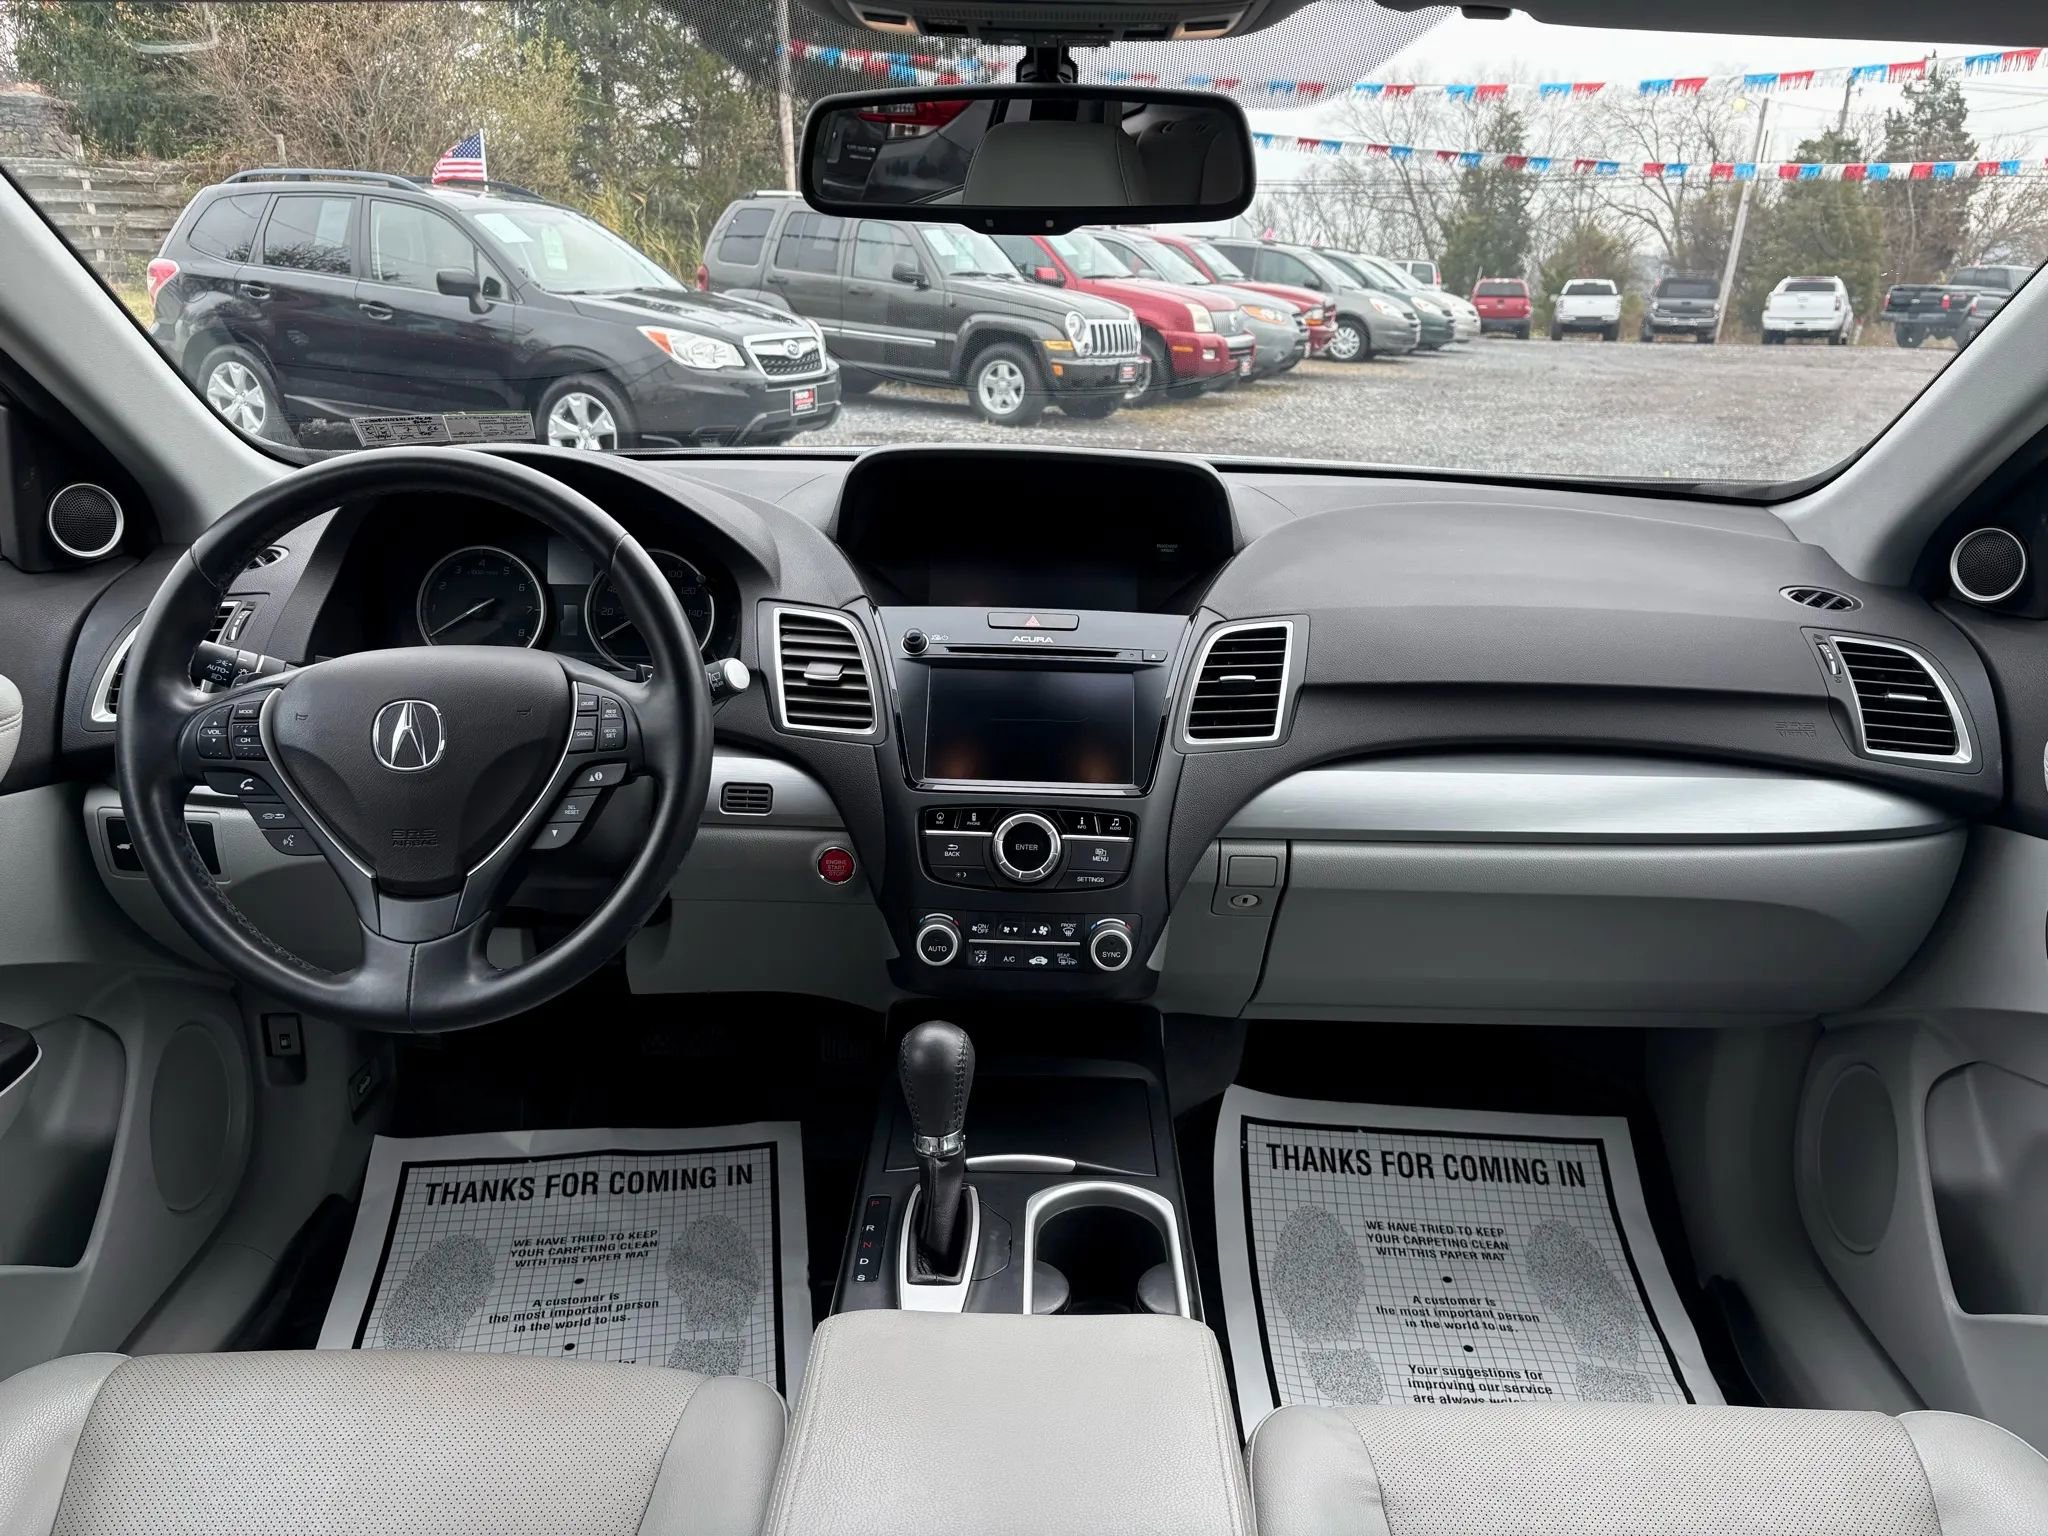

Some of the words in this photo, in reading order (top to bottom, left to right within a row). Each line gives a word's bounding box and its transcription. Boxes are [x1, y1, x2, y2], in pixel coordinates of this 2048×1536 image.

[503, 567, 510, 575] 5
[518, 584, 526, 592] 6
[526, 605, 533, 614] 7
[600, 607, 614, 616] 20
[518, 628, 525, 637] 8
[1012, 635, 1054, 644] ACURA
[206, 664, 226, 674] AUTO
[1266, 1144, 1372, 1176] THANKS
[1381, 1150, 1434, 1179] FOR
[1443, 1154, 1550, 1186] COMING
[1557, 1160, 1586, 1188] IN
[426, 1177, 535, 1206] THANKS
[544, 1171, 599, 1198] FOR
[610, 1166, 716, 1194] COMING
[727, 1164, 752, 1186] IN
[1366, 1220, 1384, 1230] WE
[1388, 1222, 1418, 1232] HAVE
[1420, 1224, 1454, 1234] TRIED
[1456, 1226, 1472, 1236] TO
[1476, 1227, 1504, 1238] KEEP
[514, 1239, 533, 1247] WE
[536, 1236, 568, 1246] HAVE
[571, 1234, 606, 1244] TRIED
[609, 1232, 624, 1240] TO
[628, 1230, 658, 1240] KEEP
[1366, 1232, 1400, 1244] YOUR
[1403, 1235, 1468, 1248] CARPETING
[1471, 1239, 1509, 1250] CLEAN
[510, 1248, 544, 1258] YOUR
[548, 1242, 616, 1256] CARPETING
[620, 1240, 658, 1250] CLEAN
[1376, 1246, 1406, 1256] WITH
[1410, 1248, 1436, 1258] THIS
[1440, 1250, 1478, 1260] PAPER
[1481, 1252, 1505, 1261] MAT
[515, 1258, 547, 1268] WITH
[550, 1256, 578, 1265] THIS
[582, 1252, 622, 1263] PAPER
[625, 1250, 650, 1260] MAT
[532, 1300, 542, 1308] A
[545, 1295, 606, 1306] customer
[609, 1292, 620, 1300] is
[1412, 1296, 1422, 1304] A
[1424, 1296, 1481, 1306] customer
[1484, 1298, 1496, 1306] is
[489, 1314, 509, 1324] the
[514, 1310, 546, 1321] most
[550, 1303, 612, 1318] important
[616, 1300, 659, 1312] person
[1376, 1304, 1396, 1315] the
[1400, 1308, 1430, 1316] most
[1434, 1308, 1494, 1319] important
[1497, 1312, 1540, 1322] person
[514, 1324, 526, 1332] in
[530, 1322, 550, 1332] the
[555, 1316, 592, 1329] world
[596, 1316, 608, 1324] to
[612, 1314, 632, 1322] us.
[1404, 1318, 1417, 1328] in
[1420, 1319, 1440, 1328] the
[1444, 1320, 1480, 1330] world
[1482, 1321, 1496, 1330] to
[1498, 1324, 1518, 1333] us.
[1408, 1364, 1438, 1375] Your
[1442, 1367, 1522, 1379] suggestions
[1524, 1369, 1543, 1380] for
[1408, 1378, 1476, 1393] improving
[1478, 1383, 1500, 1392] our
[1504, 1384, 1553, 1394] service
[1413, 1394, 1435, 1404] are
